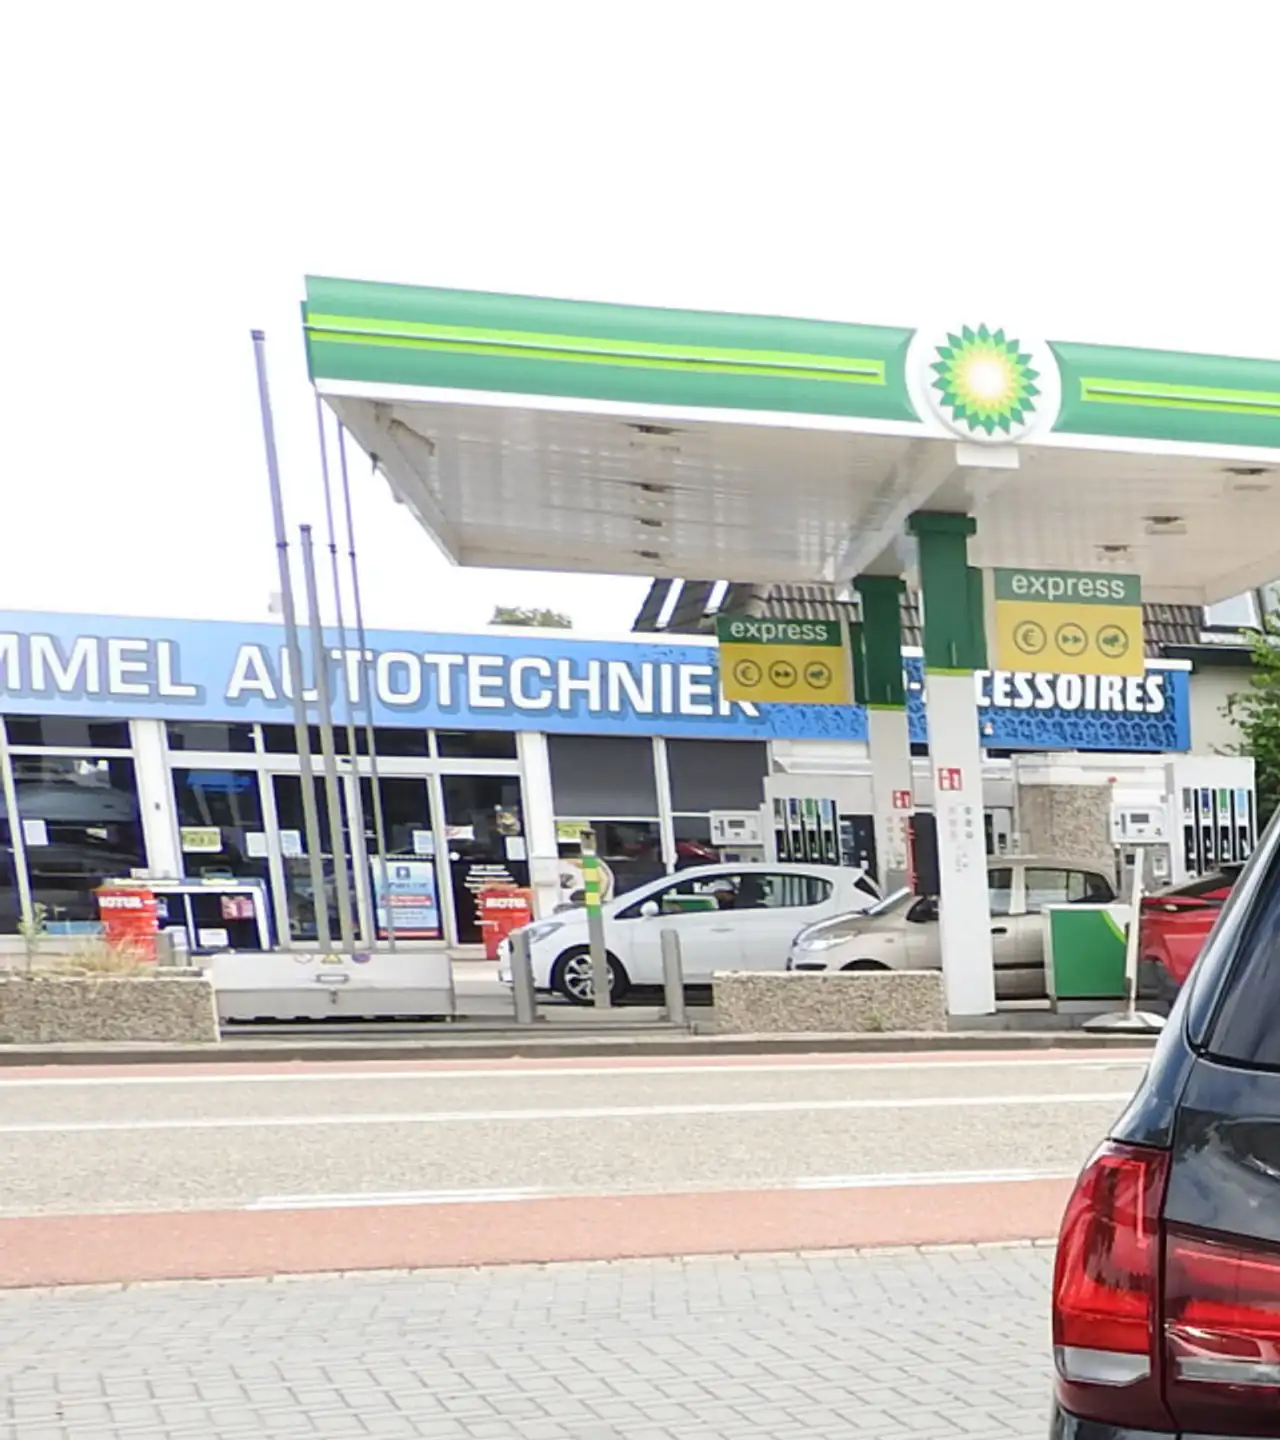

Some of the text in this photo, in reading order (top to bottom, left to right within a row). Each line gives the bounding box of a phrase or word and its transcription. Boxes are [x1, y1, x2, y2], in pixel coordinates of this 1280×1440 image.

[1011, 573, 1127, 600] express
[730, 620, 829, 642] express
[225, 644, 761, 717] ATOTECHNIE
[974, 670, 1166, 713] CESSOIRES
